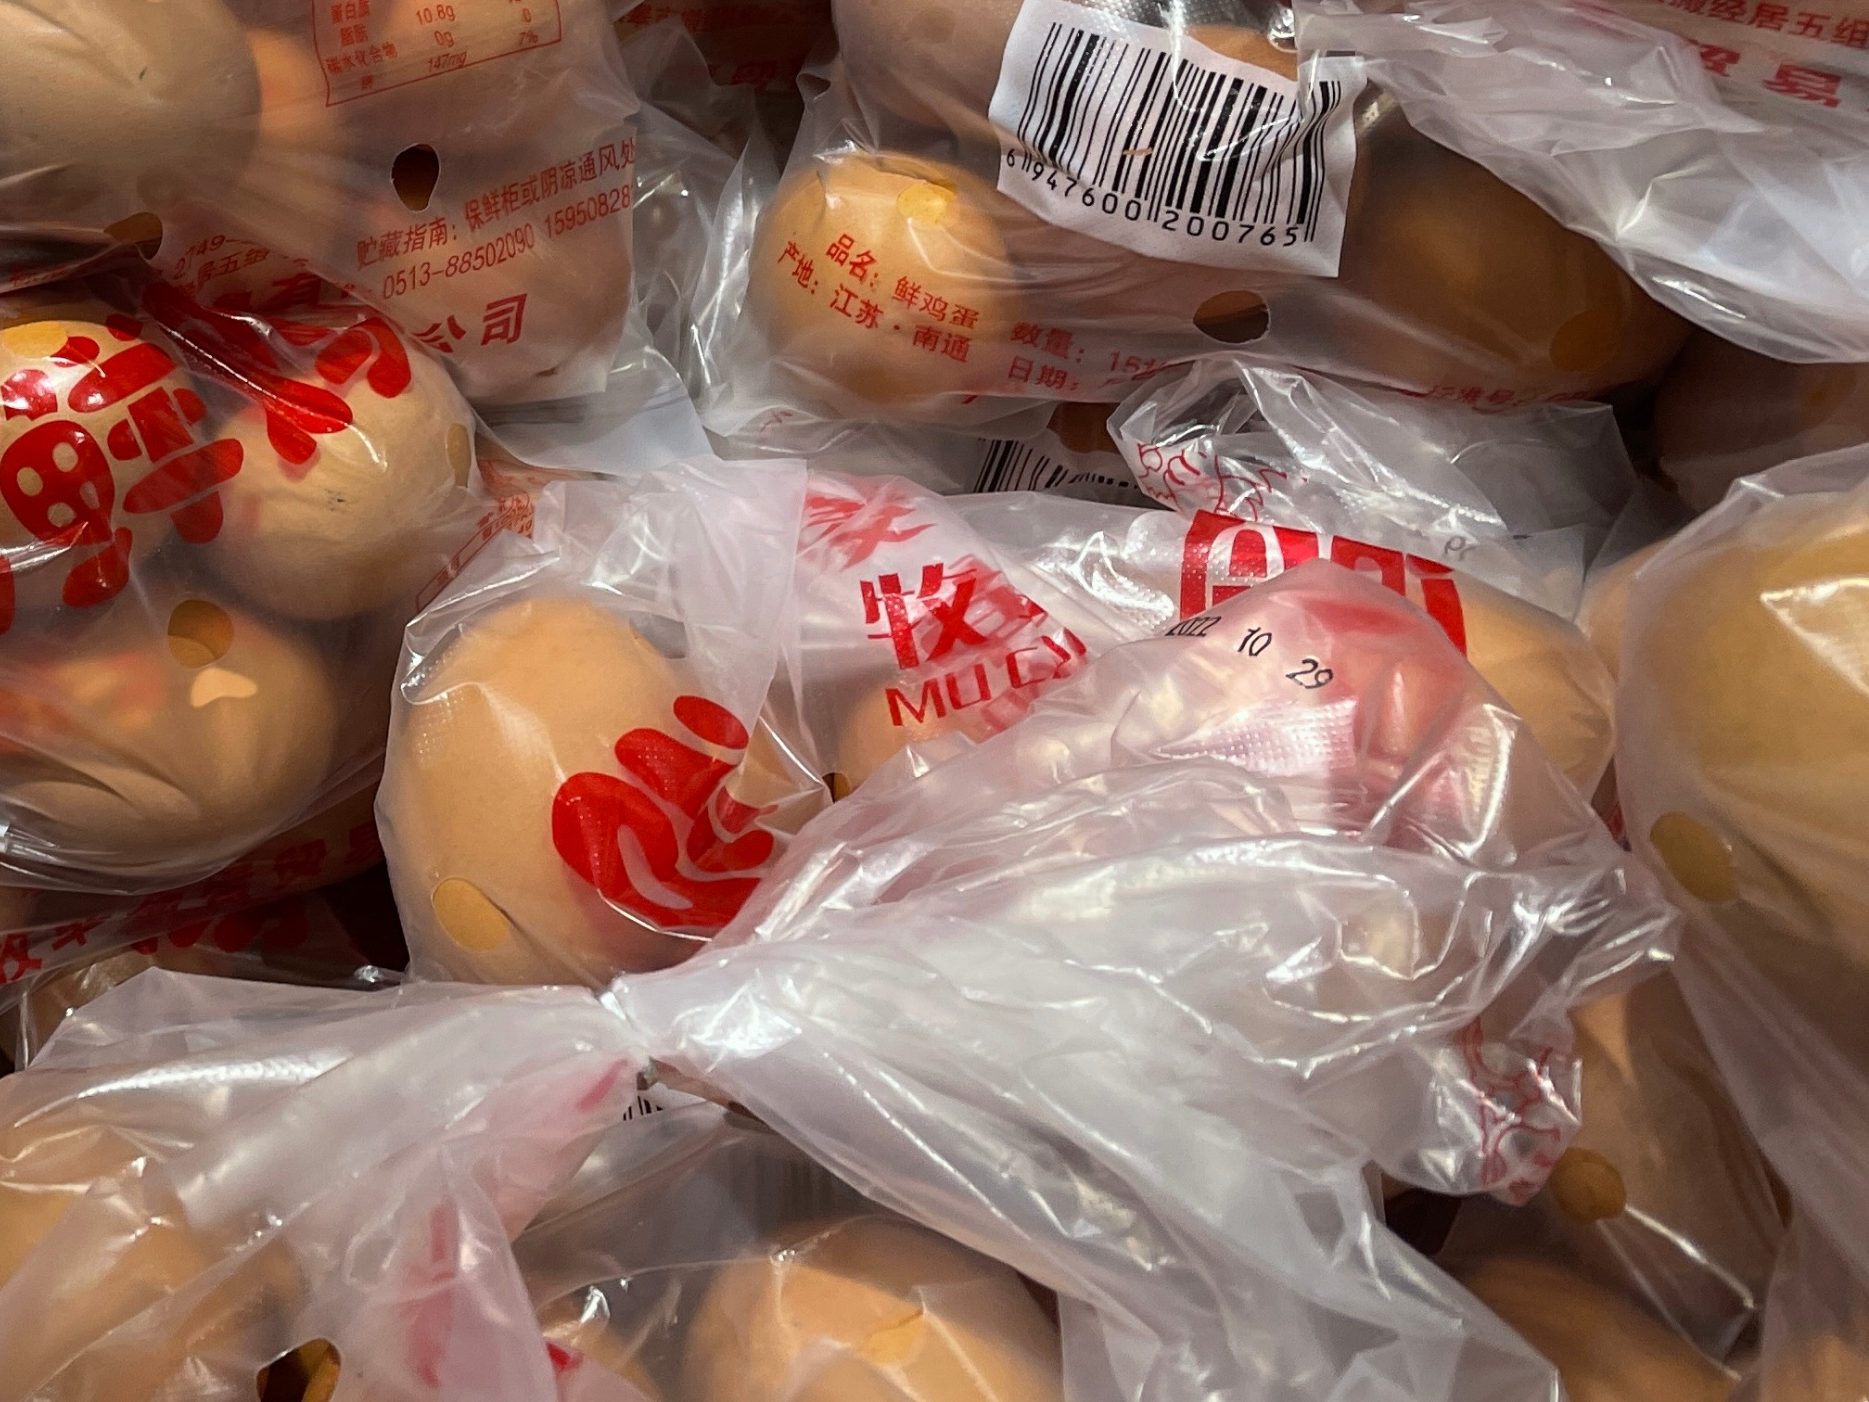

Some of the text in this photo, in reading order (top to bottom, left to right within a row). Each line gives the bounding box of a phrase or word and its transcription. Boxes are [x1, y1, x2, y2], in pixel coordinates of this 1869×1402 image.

[416, 5, 456, 26] 10.8g
[434, 30, 455, 47] 0g
[544, 184, 633, 239] 15950828
[826, 233, 980, 330] 品名：鲜鸡蛋
[1237, 627, 1272, 657] 10
